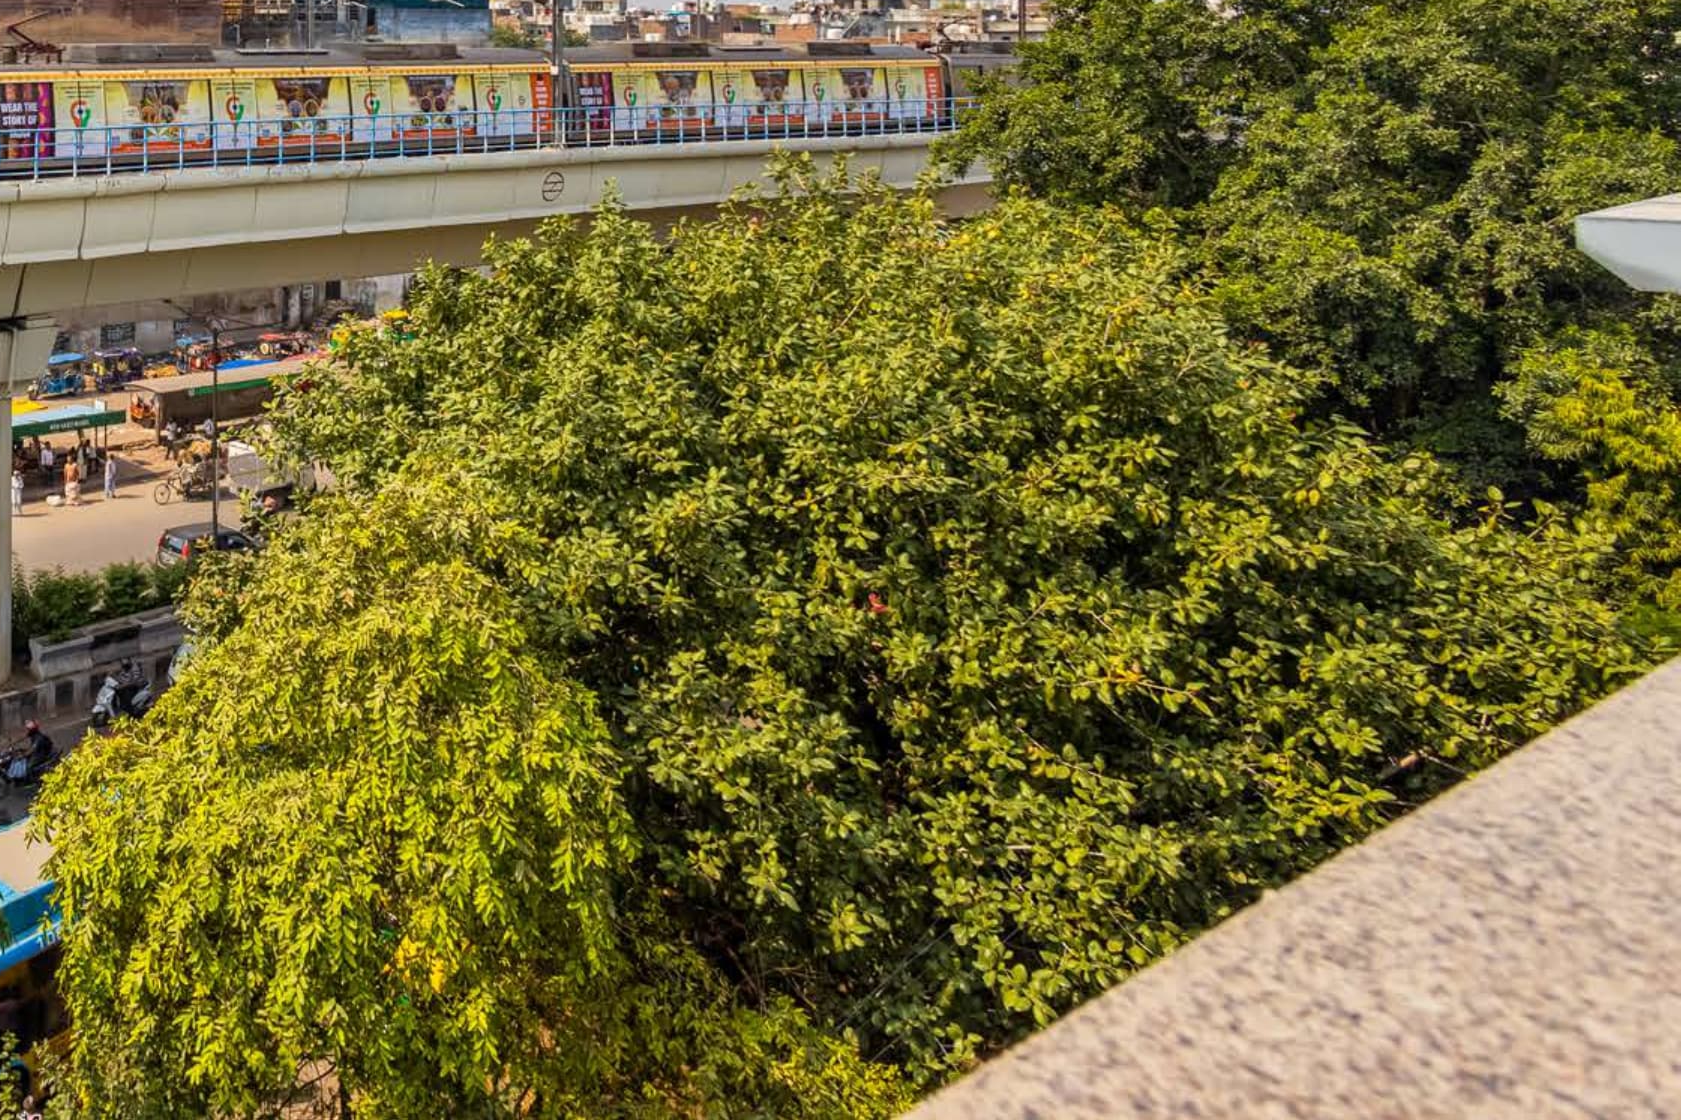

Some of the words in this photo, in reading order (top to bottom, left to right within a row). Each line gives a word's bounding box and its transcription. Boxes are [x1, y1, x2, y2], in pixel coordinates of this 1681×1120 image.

[0, 103, 22, 113] WEAR
[24, 102, 37, 112] THE
[2, 116, 26, 126] STORY
[28, 115, 37, 125] OF
